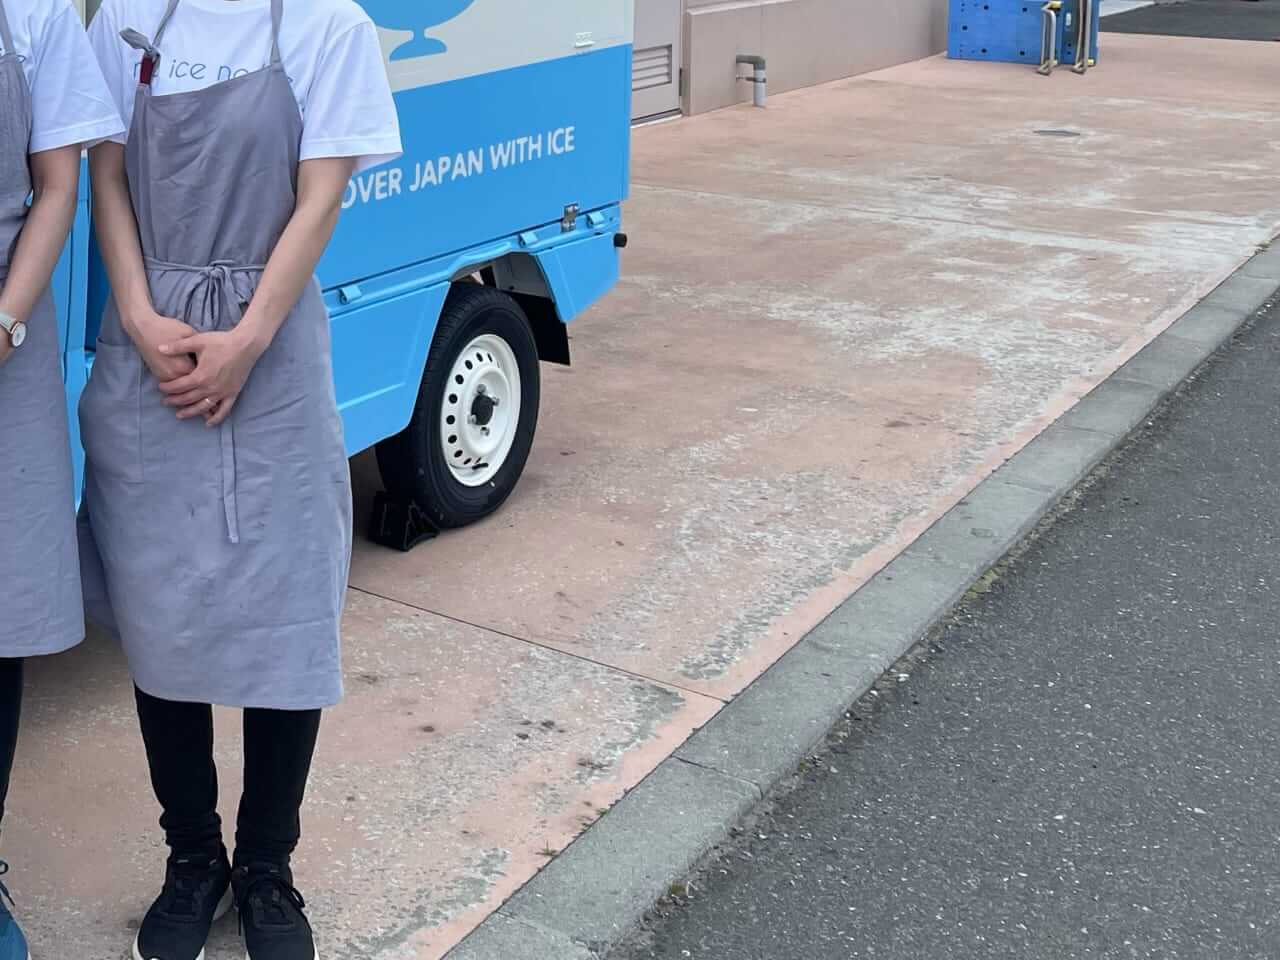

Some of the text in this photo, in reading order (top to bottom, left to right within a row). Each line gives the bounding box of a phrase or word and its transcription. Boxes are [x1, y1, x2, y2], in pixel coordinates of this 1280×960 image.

[169, 59, 207, 80] ice
[409, 147, 484, 192] JAPAN
[489, 133, 542, 171] WITH
[547, 125, 576, 155] ICE
